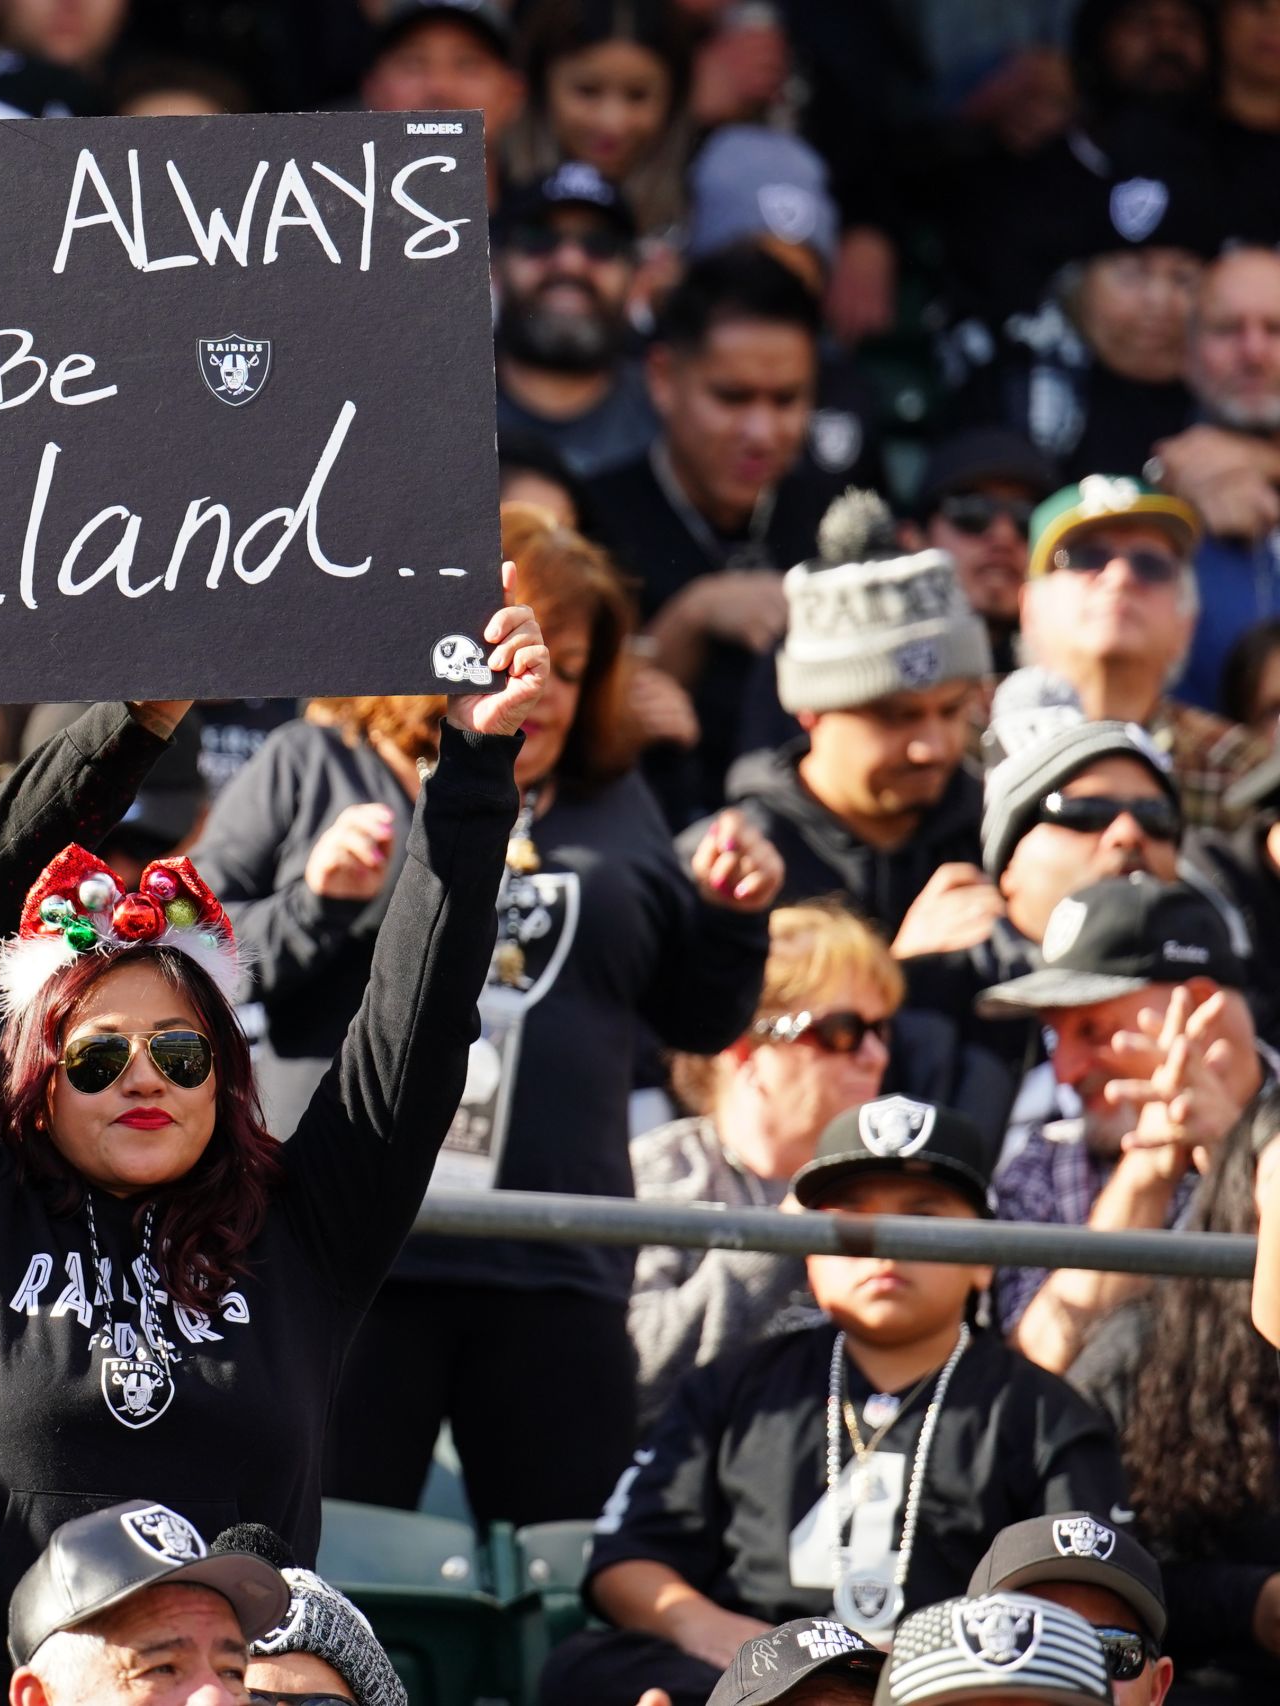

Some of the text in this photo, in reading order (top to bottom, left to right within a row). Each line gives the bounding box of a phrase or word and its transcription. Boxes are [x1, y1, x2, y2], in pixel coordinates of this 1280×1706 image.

[406, 123, 463, 134] RAIDERS
[53, 141, 470, 274] ALWAYS
[207, 343, 263, 352] RAIDERS
[812, 1620, 846, 1633] THE
[797, 1629, 864, 1650] BLACK
[809, 1643, 855, 1659] HOL
